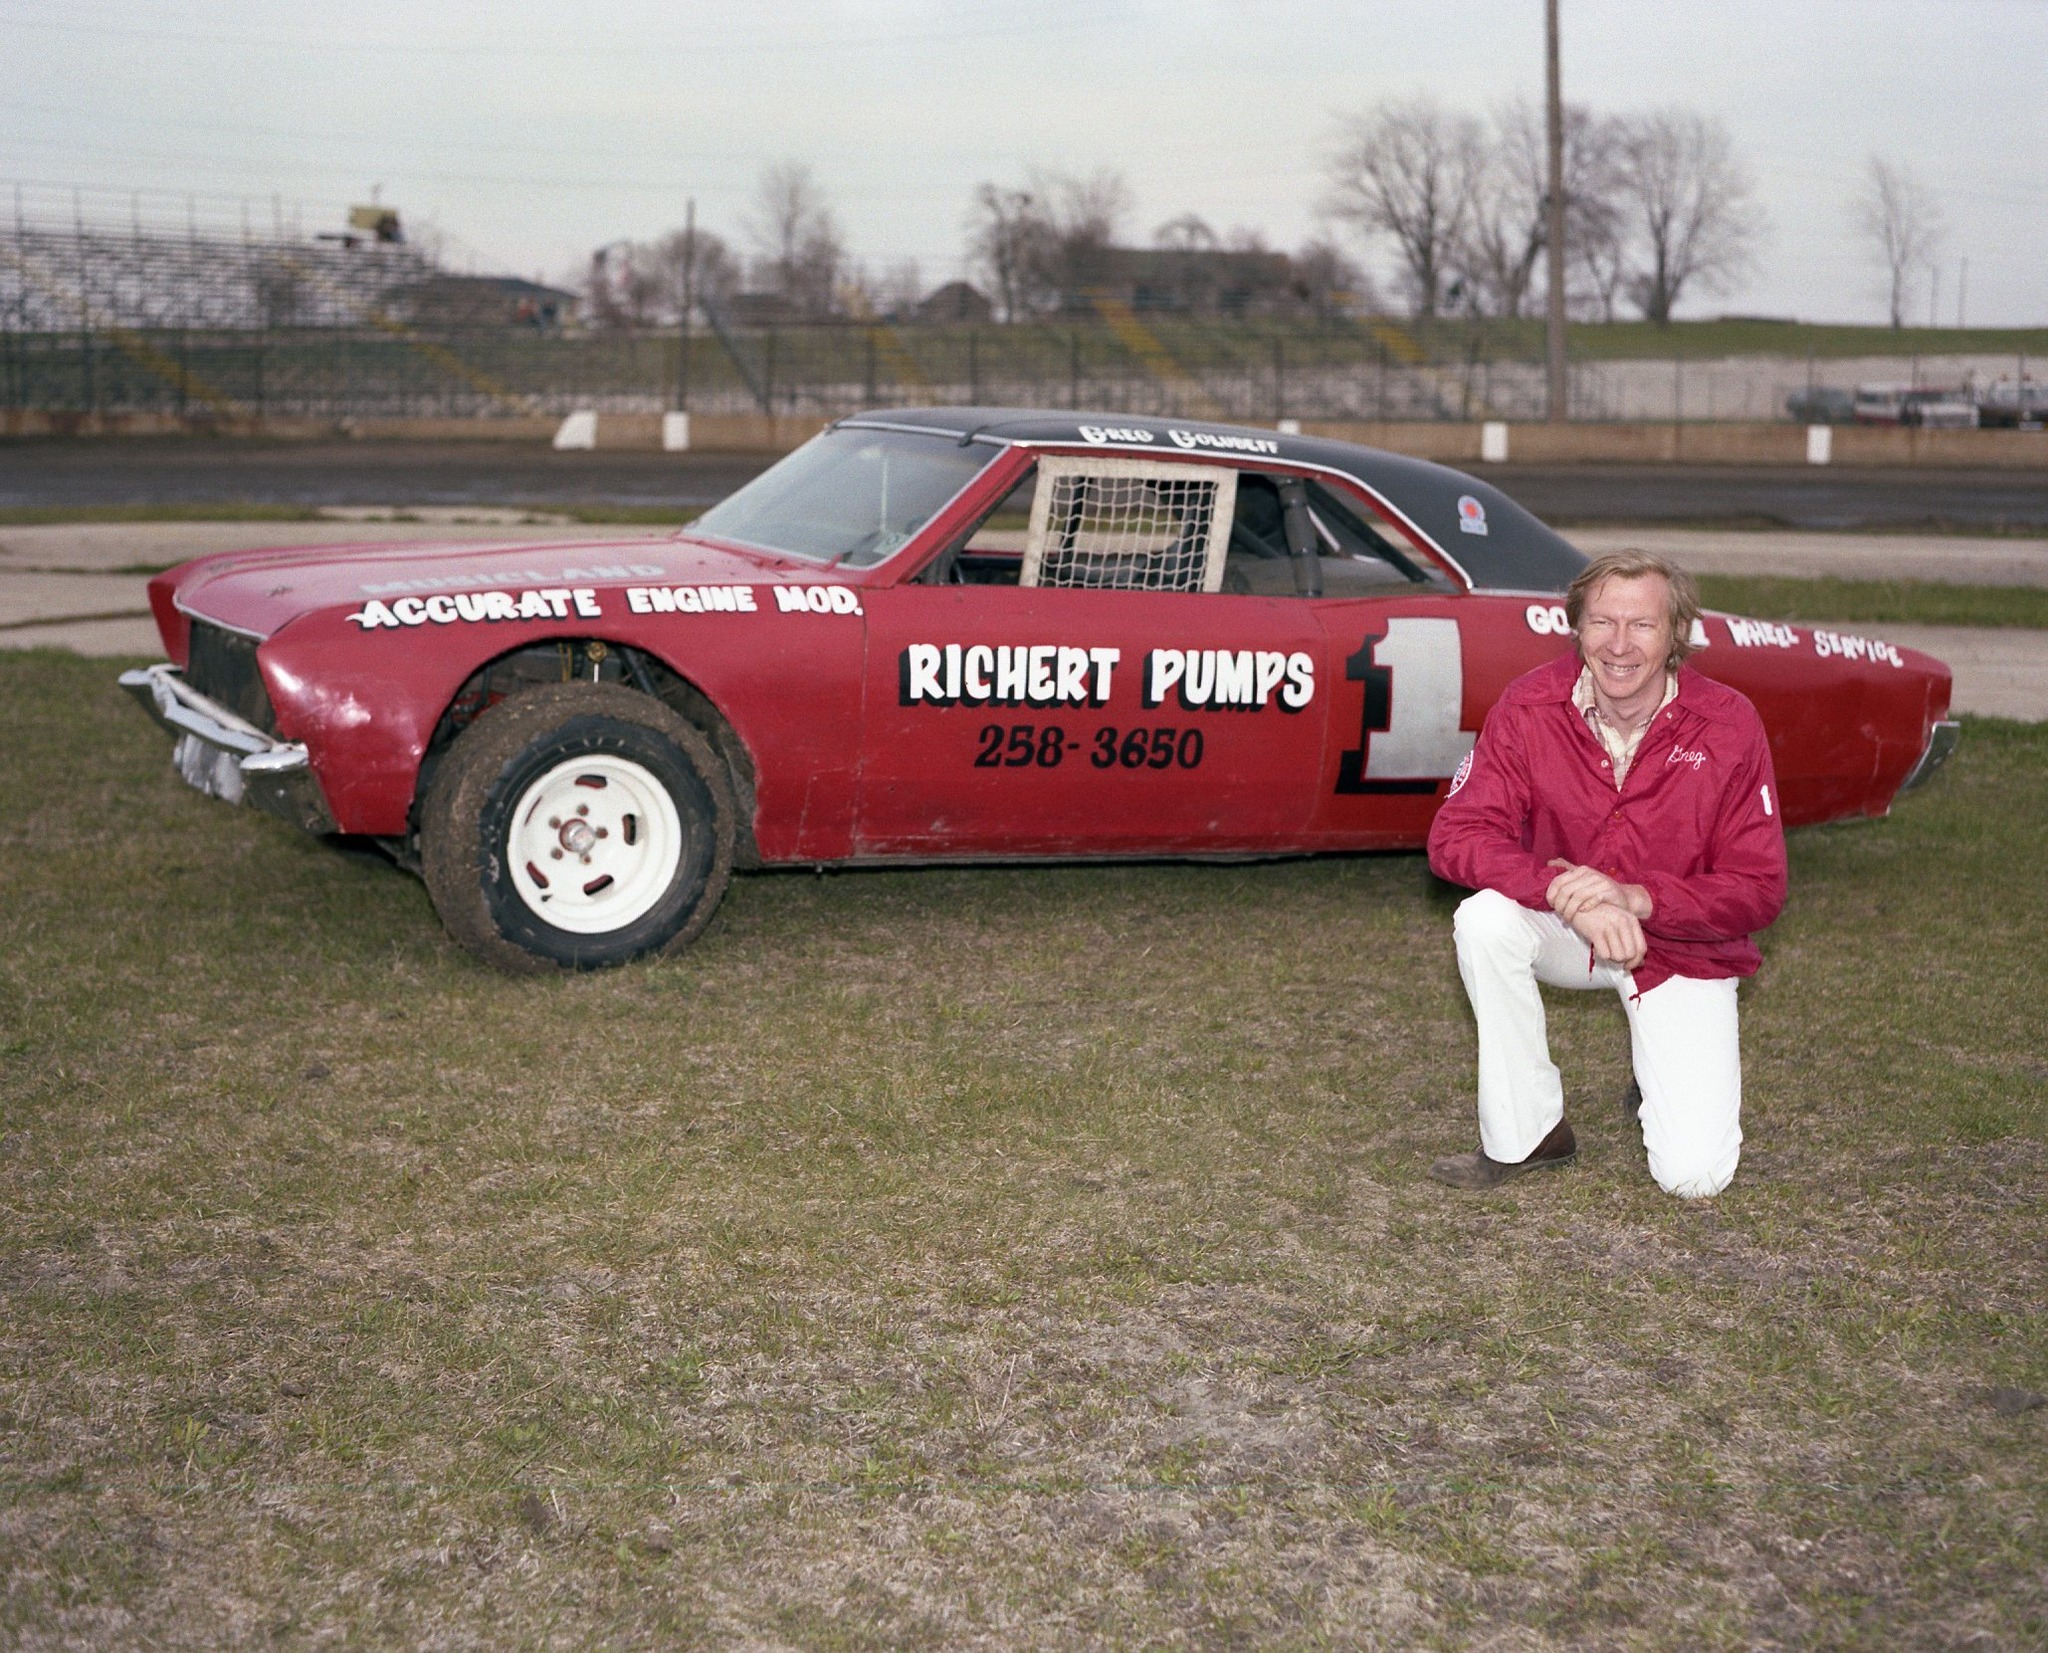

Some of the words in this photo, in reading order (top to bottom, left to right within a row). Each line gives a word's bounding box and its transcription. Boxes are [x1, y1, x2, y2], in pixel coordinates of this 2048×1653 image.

[346, 588, 602, 629] ACCURATE
[626, 586, 758, 614] ENGINE
[772, 585, 864, 616] MOD.
[1725, 617, 1800, 649] WHEEL
[1812, 629, 1905, 668] SERVICE
[907, 643, 1121, 701] RICHERT
[1149, 648, 1316, 708] PUMPS
[1364, 617, 1478, 780] 1
[1665, 744, 1707, 771] Greg
[1759, 784, 1773, 816] 1
